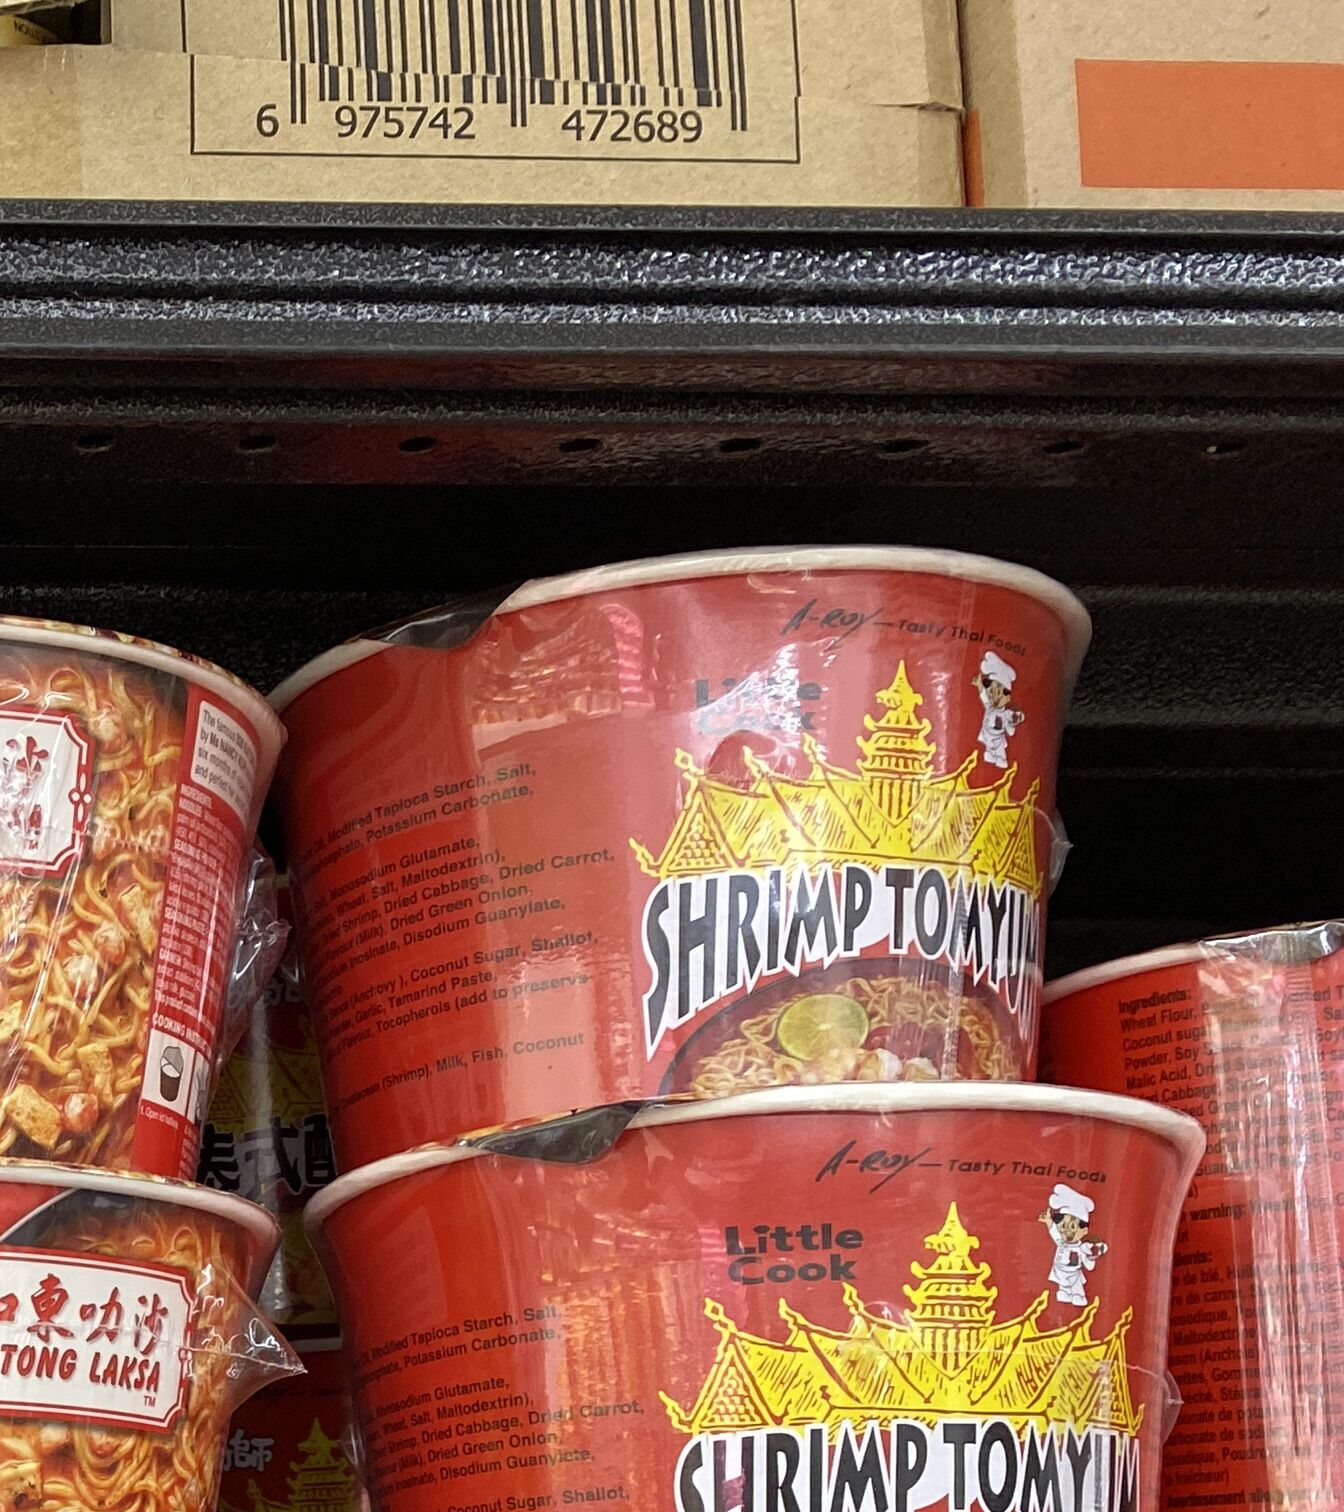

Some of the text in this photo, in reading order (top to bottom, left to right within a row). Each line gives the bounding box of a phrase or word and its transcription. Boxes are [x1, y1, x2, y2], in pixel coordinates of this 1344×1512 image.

[255, 104, 703, 146] 6 975742 472689
[499, 858, 545, 880] Dried
[550, 849, 615, 870] Carrot,
[645, 866, 874, 1052] SHRIMP
[512, 1032, 586, 1055] Coconut
[948, 1157, 1005, 1177] Tasty
[1011, 1160, 1052, 1178] Thai
[1056, 1163, 1108, 1184] Foods
[725, 1223, 863, 1250] Little
[728, 1253, 859, 1284] Cook
[88, 1349, 162, 1389] LAKSA
